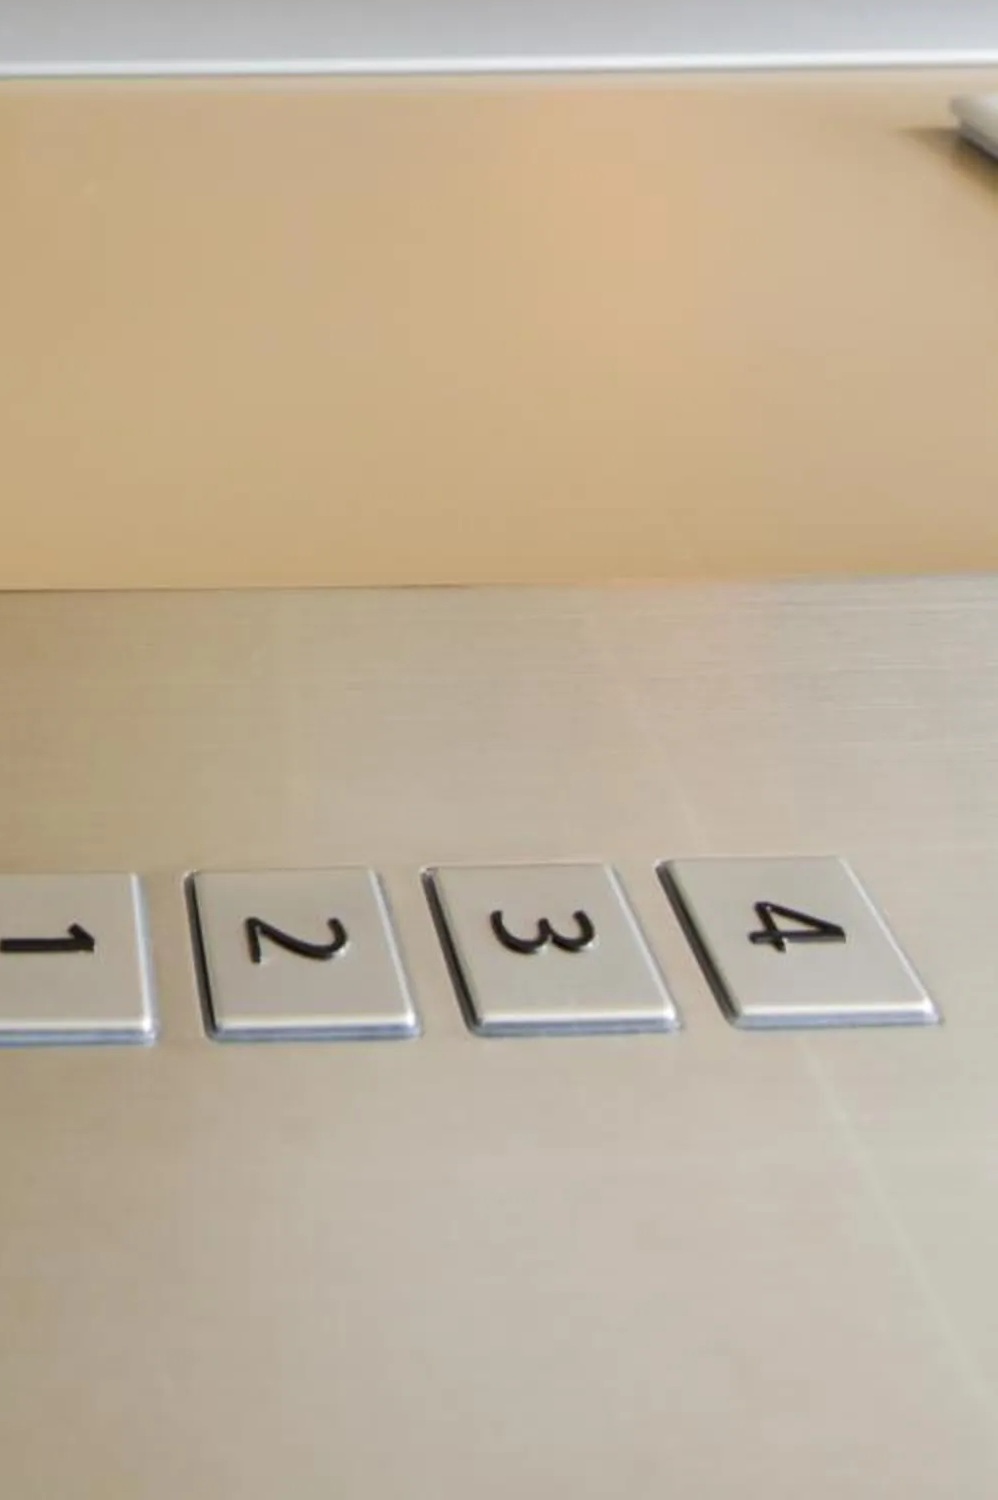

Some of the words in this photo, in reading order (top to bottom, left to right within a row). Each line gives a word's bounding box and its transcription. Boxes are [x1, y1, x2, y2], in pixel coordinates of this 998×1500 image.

[244, 917, 348, 964] 2
[489, 909, 595, 956] 3
[748, 900, 846, 952] 4
